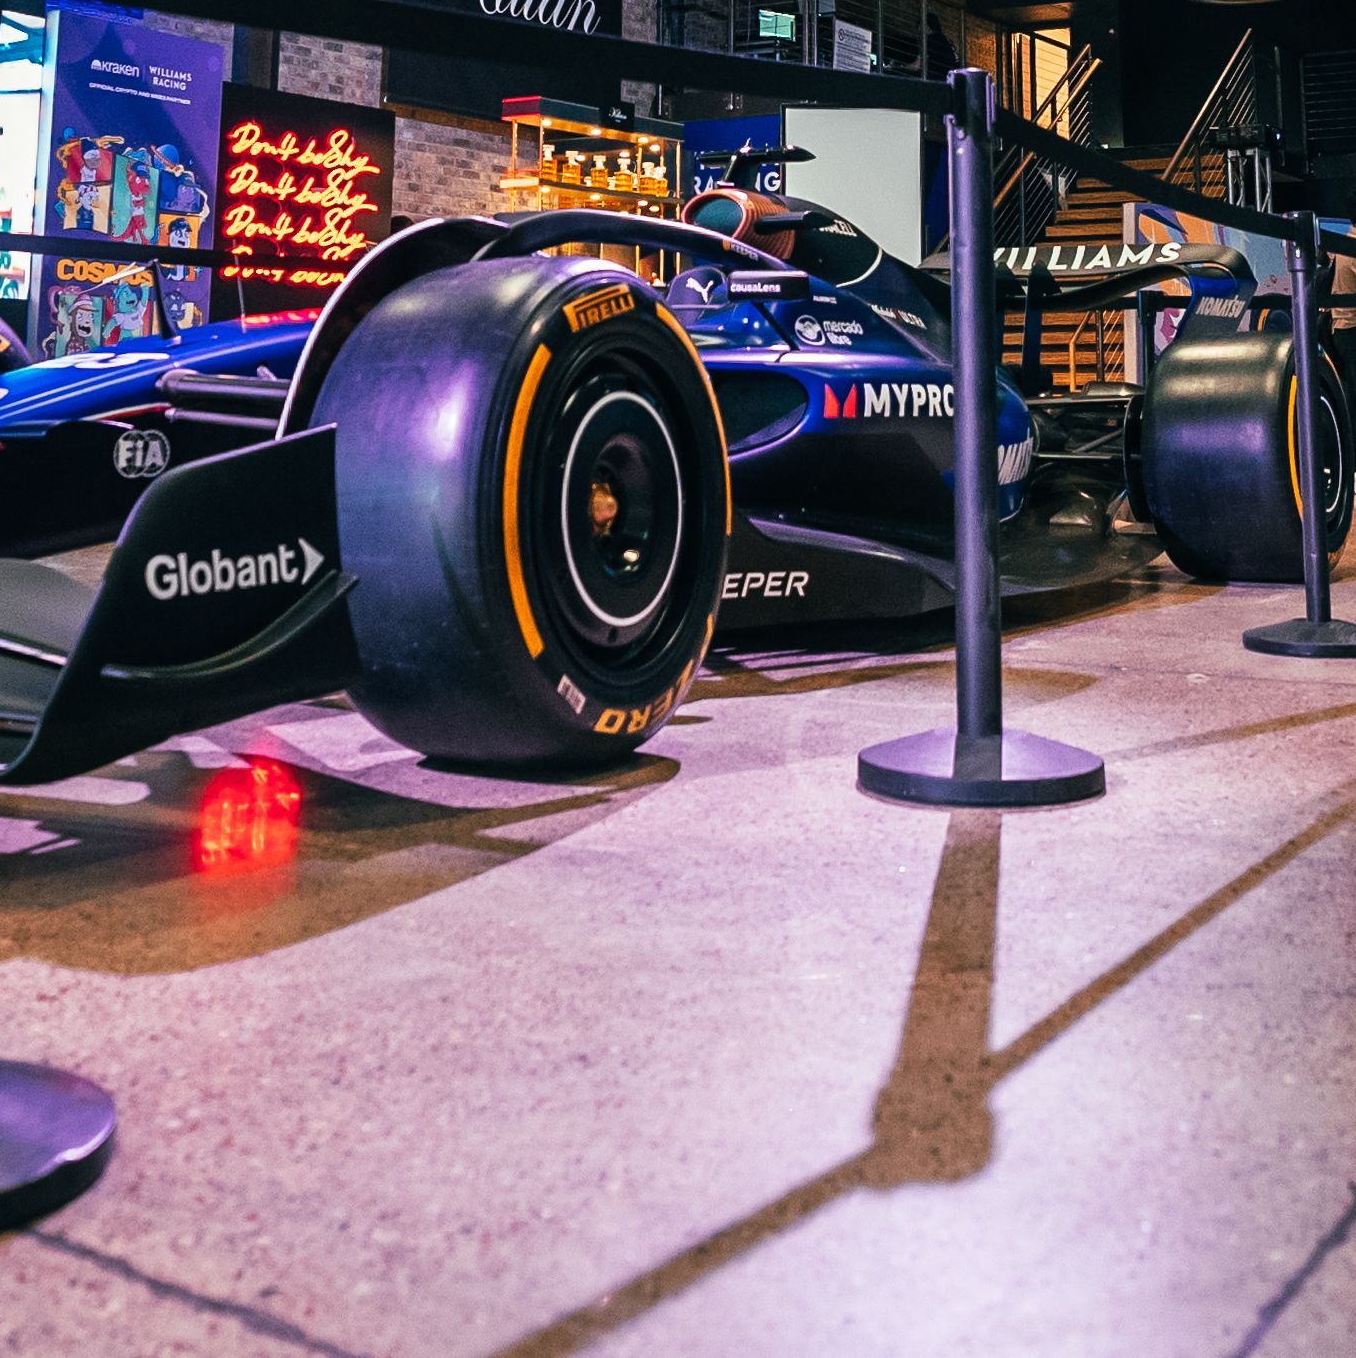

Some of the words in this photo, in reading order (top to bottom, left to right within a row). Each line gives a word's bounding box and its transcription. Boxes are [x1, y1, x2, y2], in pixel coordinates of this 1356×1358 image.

[102, 61, 140, 78] kraken
[149, 65, 192, 82] WILLIAMS
[152, 76, 187, 91] RACING
[562, 283, 635, 334] PIRELLI
[864, 383, 955, 418] MYPRO
[145, 544, 299, 600] Globant
[722, 571, 810, 599] EPER
